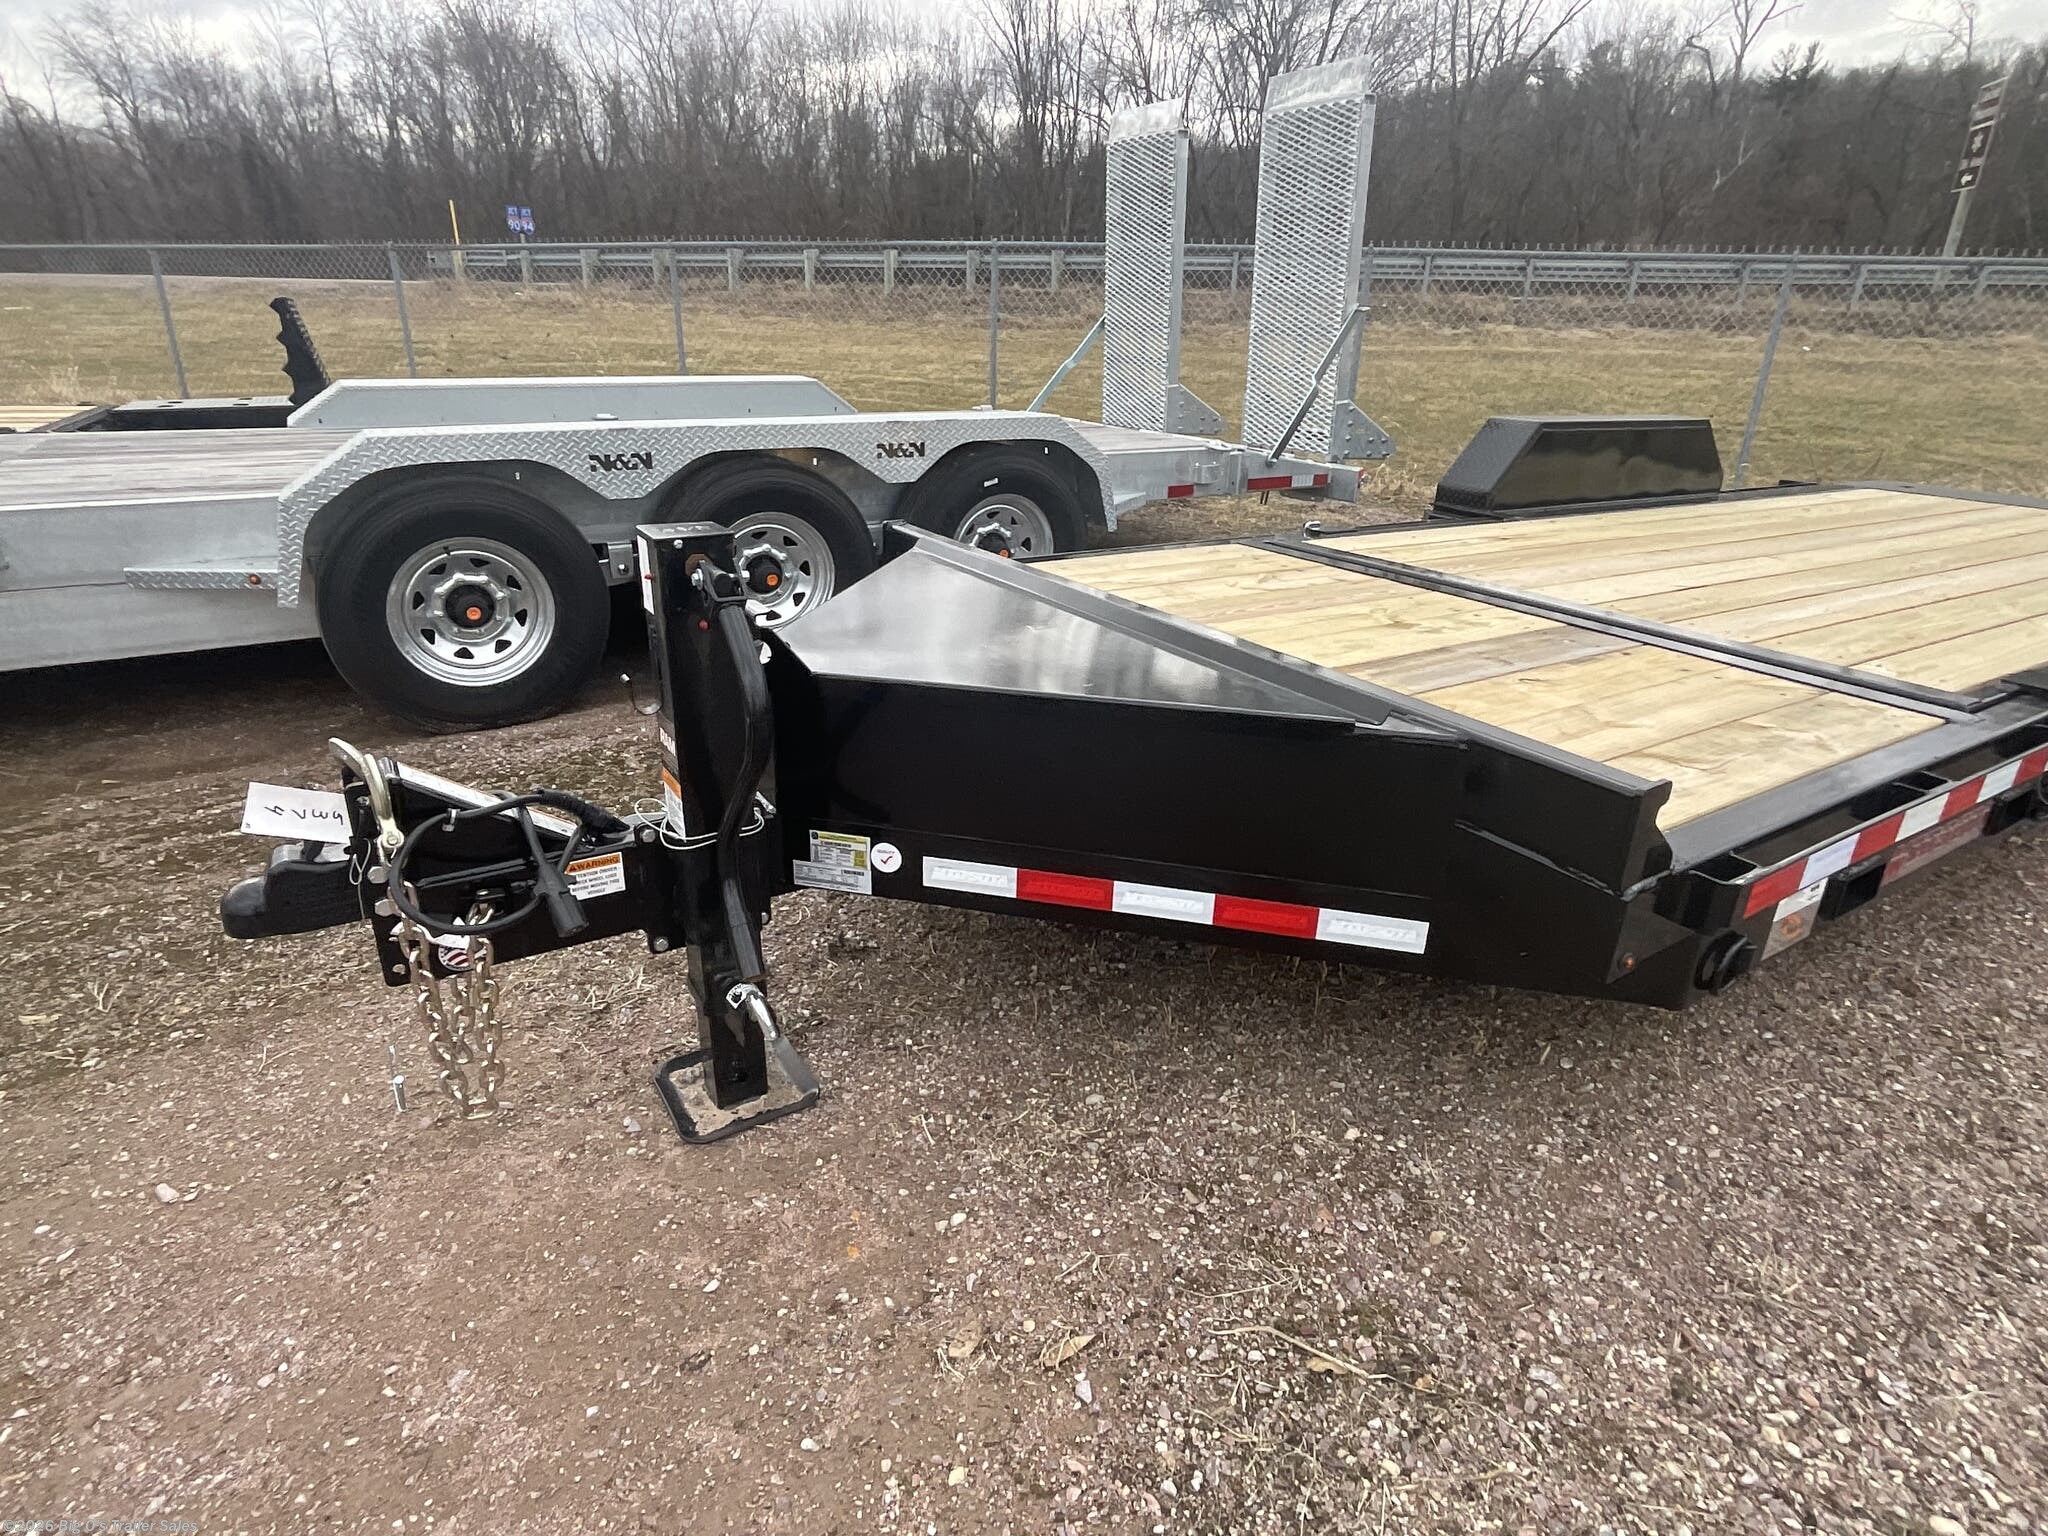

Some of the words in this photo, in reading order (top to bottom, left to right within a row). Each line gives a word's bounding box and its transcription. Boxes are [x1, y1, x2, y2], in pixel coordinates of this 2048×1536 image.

[508, 219, 520, 231] 90
[521, 220, 534, 232] 94
[576, 856, 619, 870] WARNING
